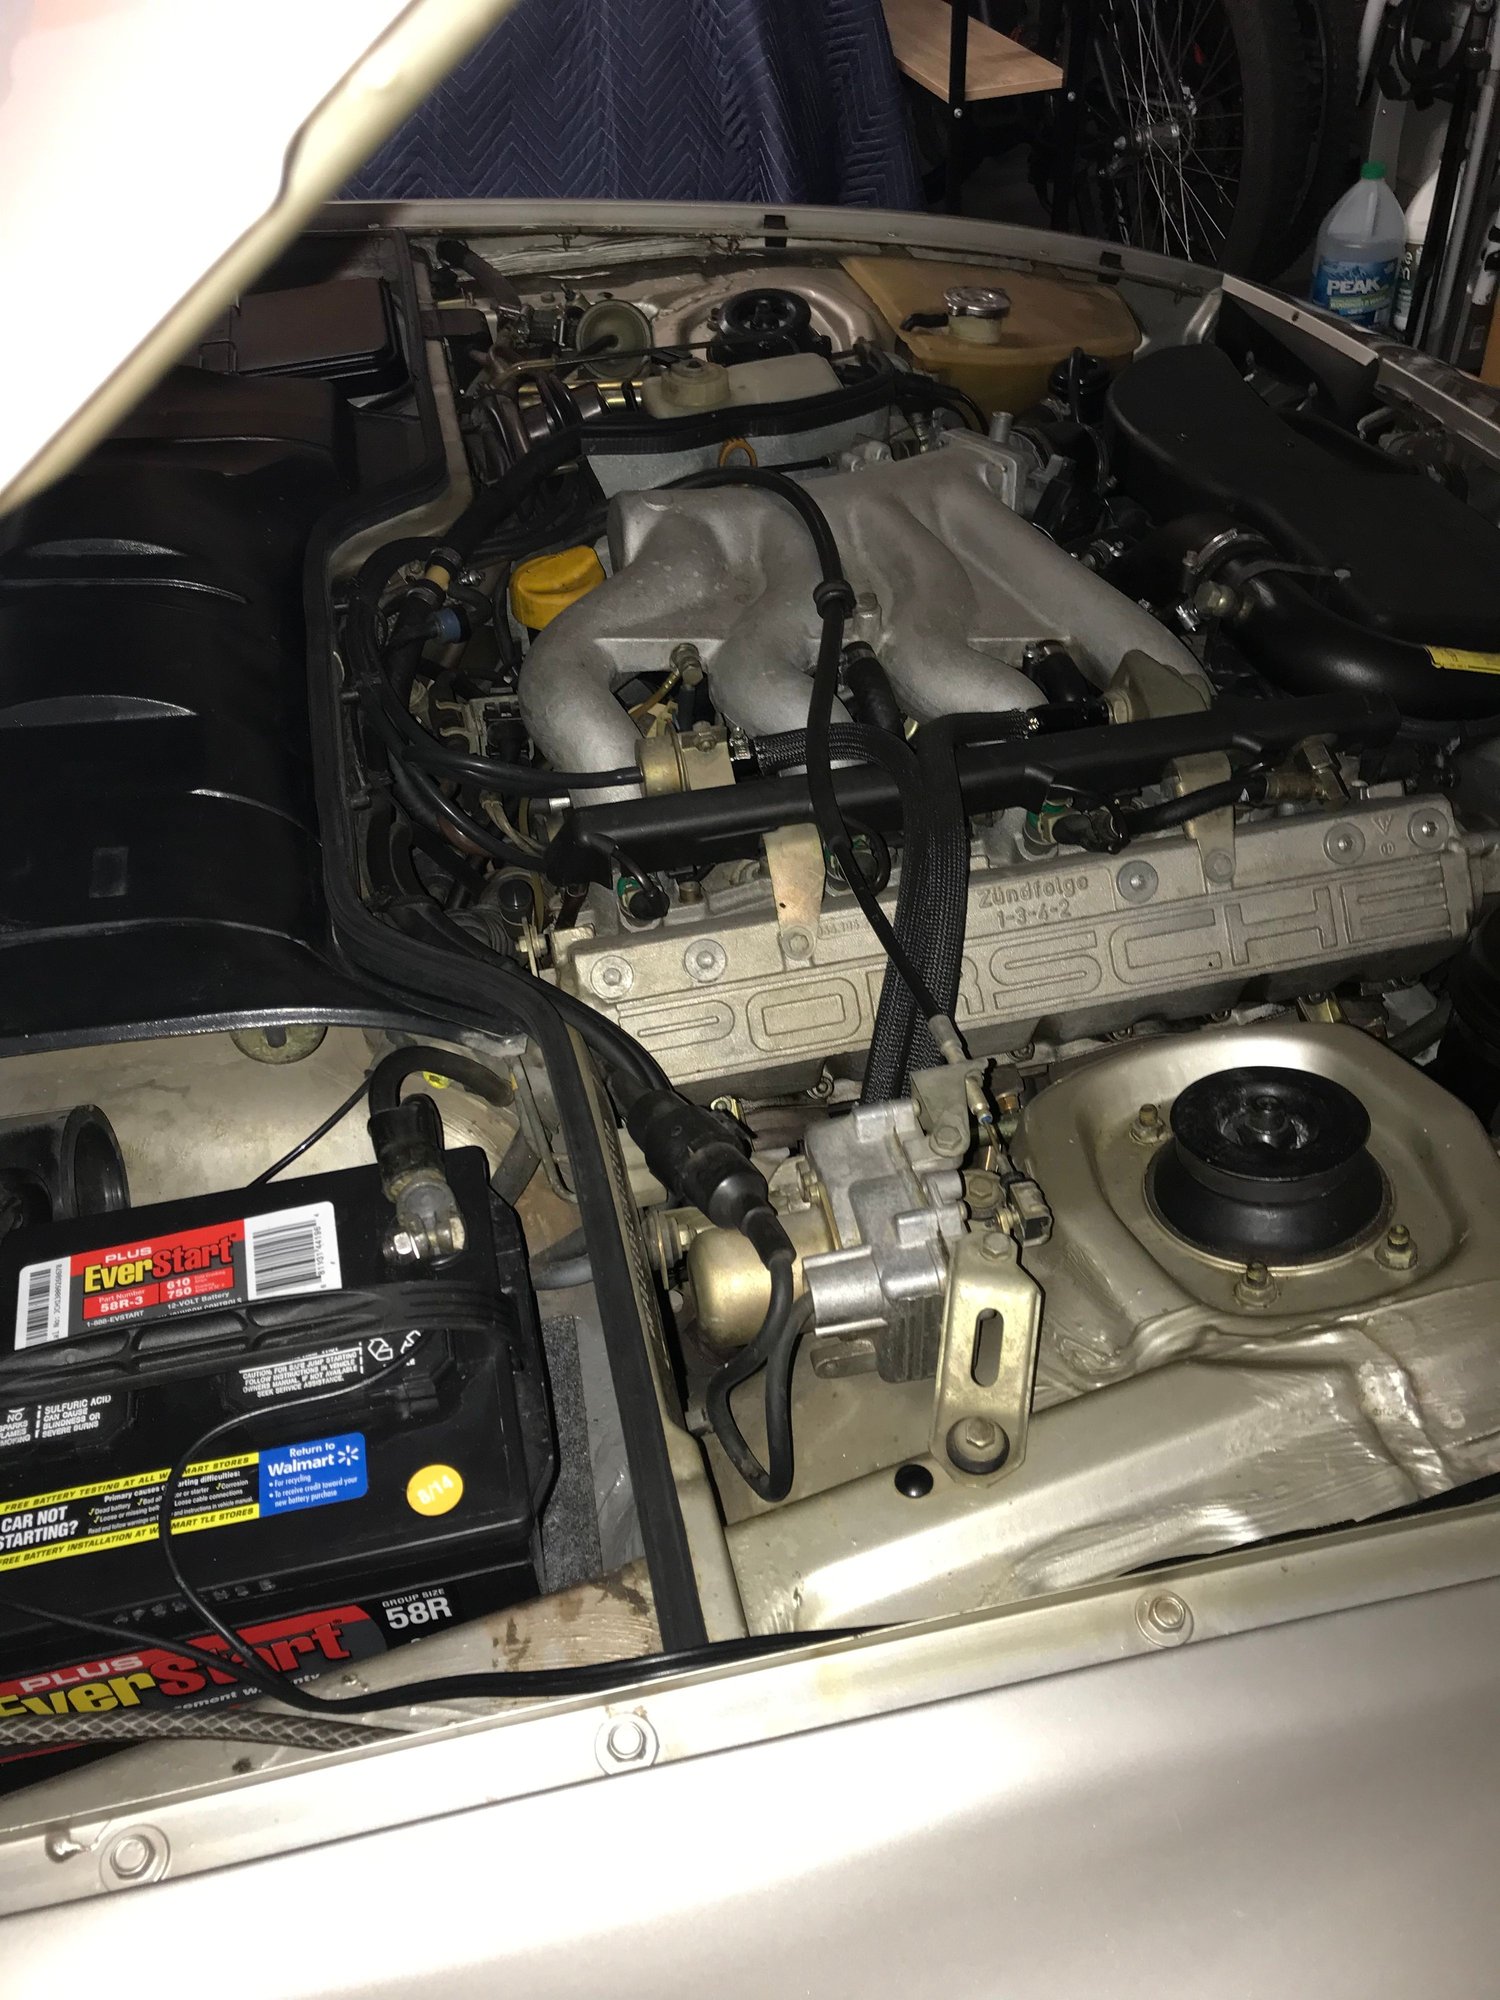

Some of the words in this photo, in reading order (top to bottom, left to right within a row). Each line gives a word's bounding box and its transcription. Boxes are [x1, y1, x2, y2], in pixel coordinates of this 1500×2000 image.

[1327, 278, 1380, 296] PEAK
[979, 874, 1090, 909] Zündfolge
[997, 899, 1071, 928] 1-3-4-2
[84, 1236, 233, 1293] EverStart
[105, 1246, 152, 1264] PLUS
[166, 1277, 191, 1290] 610
[167, 1286, 192, 1300] 750
[99, 1293, 115, 1303] Part
[116, 1289, 145, 1300] Number
[100, 1297, 144, 1313] 58R-3
[167, 1297, 199, 1310] 12-VOLT
[201, 1291, 230, 1303] Battery
[245, 1375, 272, 1386] FOLLOW
[272, 1366, 320, 1382] INSTRUCTIONS
[320, 1364, 328, 1372] IN
[329, 1359, 355, 1371] VEHICLE
[274, 1366, 288, 1375] FOR
[289, 1362, 306, 1372] SAFE
[307, 1358, 325, 1369] JUMP
[325, 1351, 357, 1364] STARTING
[242, 1383, 271, 1394] OWNERS
[301, 1374, 308, 1382] IF
[310, 1371, 324, 1381] NOT
[325, 1364, 358, 1378] AVAILABLE
[256, 1389, 274, 1398] SEEK
[275, 1383, 302, 1395] SERVICE
[303, 1374, 345, 1388] ASSISTANCE.
[44, 1399, 88, 1415] SULFURIC
[90, 1395, 112, 1406] ACID
[6, 1412, 23, 1423] NO
[42, 1415, 86, 1430] BLINDNESS
[89, 1412, 101, 1421] OR
[43, 1413, 60, 1423] CAN
[62, 1408, 88, 1419] CAUSE
[42, 1426, 72, 1438] SEVERE
[73, 1420, 99, 1432] BURNS
[289, 1444, 322, 1458] Return
[325, 1442, 336, 1451] to
[268, 1453, 335, 1477] Walmart
[4, 1501, 29, 1512] FREE
[33, 1491, 77, 1506] BATTERY
[79, 1482, 120, 1496] TESTING
[123, 1479, 137, 1487] AT
[138, 1475, 155, 1484] ALL
[213, 1456, 249, 1470] STORES
[103, 1490, 133, 1503] Primary
[134, 1486, 160, 1497] causes
[200, 1470, 241, 1484] difficulties:
[221, 1479, 249, 1490] Corrosion
[274, 1478, 284, 1488] For
[285, 1474, 312, 1486] recycling
[282, 1486, 303, 1497] receive
[304, 1482, 321, 1492] credit
[322, 1478, 343, 1489] toward
[343, 1476, 358, 1486] your
[417, 1474, 454, 1505] 8/14
[143, 1497, 154, 1506] Bad
[191, 1486, 209, 1496] starter
[174, 1498, 192, 1507] Loose
[194, 1495, 210, 1504] cable
[211, 1488, 243, 1501] connections
[275, 1499, 288, 1508] new
[288, 1494, 310, 1507] battery
[311, 1489, 338, 1502] purchase
[95, 1506, 110, 1515] Dead
[110, 1502, 131, 1513] battery
[100, 1513, 118, 1523] Loose
[125, 1507, 147, 1517] missing
[183, 1504, 212, 1515] instructions
[217, 1499, 233, 1509] vehicle
[1, 1513, 34, 1533] CAR
[36, 1505, 69, 1526] NOT
[24, 1545, 65, 1561] BATTERY
[67, 1531, 132, 1551] INSTALLATION
[134, 1529, 147, 1538] AT
[200, 1514, 217, 1524] TLE
[219, 1507, 254, 1521] STORES
[382, 1593, 419, 1608] GROUP
[422, 1587, 446, 1599] SIZE
[385, 1596, 453, 1630] 58R
[19, 1655, 144, 1693] PLUS
